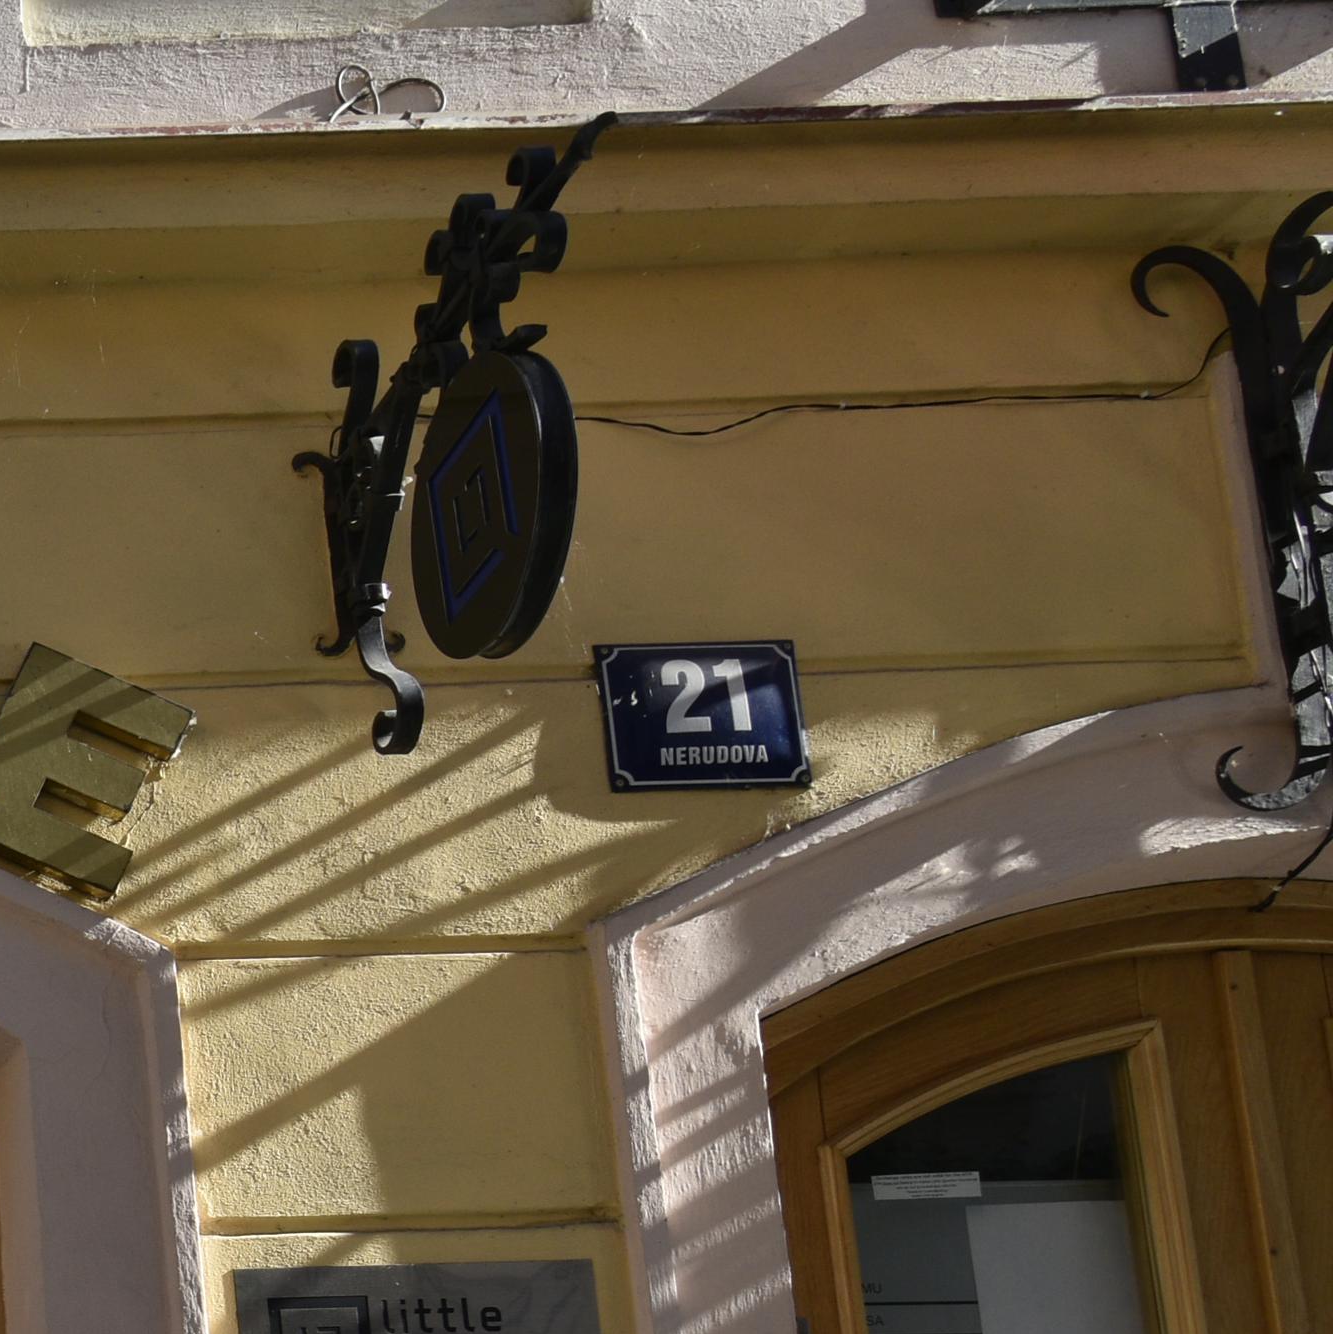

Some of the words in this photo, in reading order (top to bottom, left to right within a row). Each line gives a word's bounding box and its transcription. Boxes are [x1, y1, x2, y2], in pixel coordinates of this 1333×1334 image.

[661, 659, 752, 733] 21
[660, 745, 769, 766] NERUDOVA
[382, 1297, 502, 1334] little
